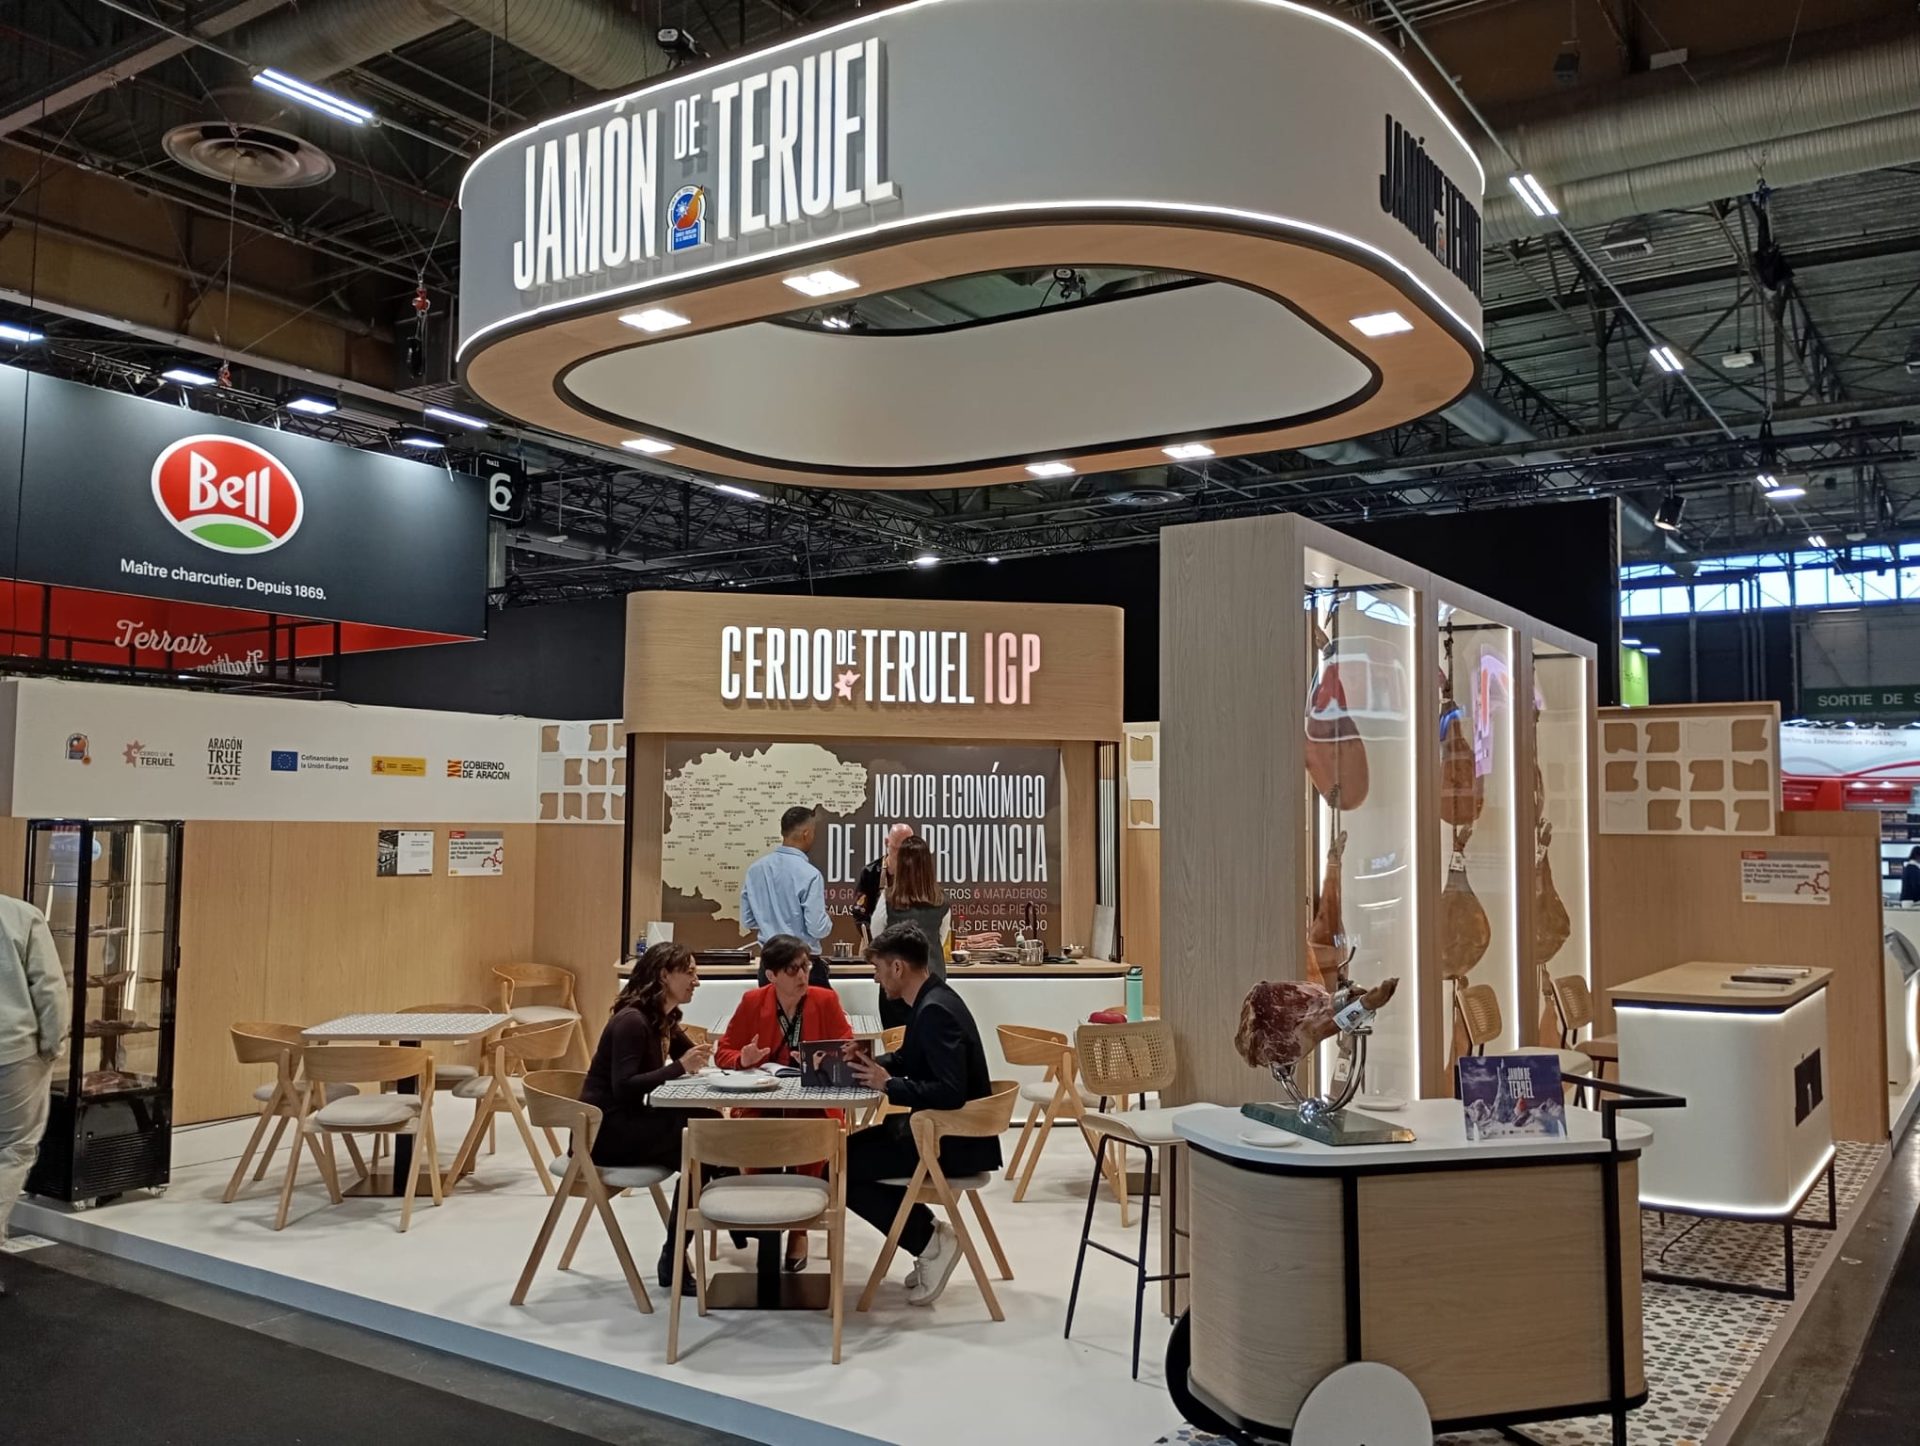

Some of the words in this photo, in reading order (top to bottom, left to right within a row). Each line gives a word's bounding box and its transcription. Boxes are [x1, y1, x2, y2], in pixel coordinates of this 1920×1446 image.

[513, 101, 659, 291] JAMÓN
[673, 93, 701, 161] DE
[712, 37, 897, 242] TERUEL
[189, 450, 271, 525] Bell
[489, 472, 513, 512] 6
[120, 557, 168, 579] Maître
[171, 566, 245, 590] charcutier.
[245, 576, 293, 597] Depuis
[293, 584, 327, 602] 1869.
[114, 619, 213, 656] Terroir
[720, 625, 833, 702] CERDO
[836, 629, 857, 666] DE
[861, 628, 975, 705] TERUEL
[984, 631, 1042, 705] IGP
[1818, 694, 1874, 708] SORTIE
[1882, 693, 1904, 706] DE
[208, 736, 243, 750] ARAGÓN
[140, 757, 175, 767] TERUEL
[208, 749, 242, 764] TRUE
[301, 754, 339, 762] Cofinanciado
[207, 763, 241, 775] TASTE
[325, 763, 350, 771] Europea
[462, 760, 505, 771] GOBIERNO
[462, 770, 474, 779] DE
[874, 773, 937, 819] MOTOR
[942, 761, 1046, 819] ECONÓMICO
[827, 823, 856, 883] DE
[920, 823, 1048, 884] PROVINCIA
[973, 889, 981, 900] 6
[982, 888, 1048, 900] MATADEROS
[951, 904, 990, 916] BRICAS
[992, 904, 1006, 916] DE
[974, 920, 989, 931] DE
